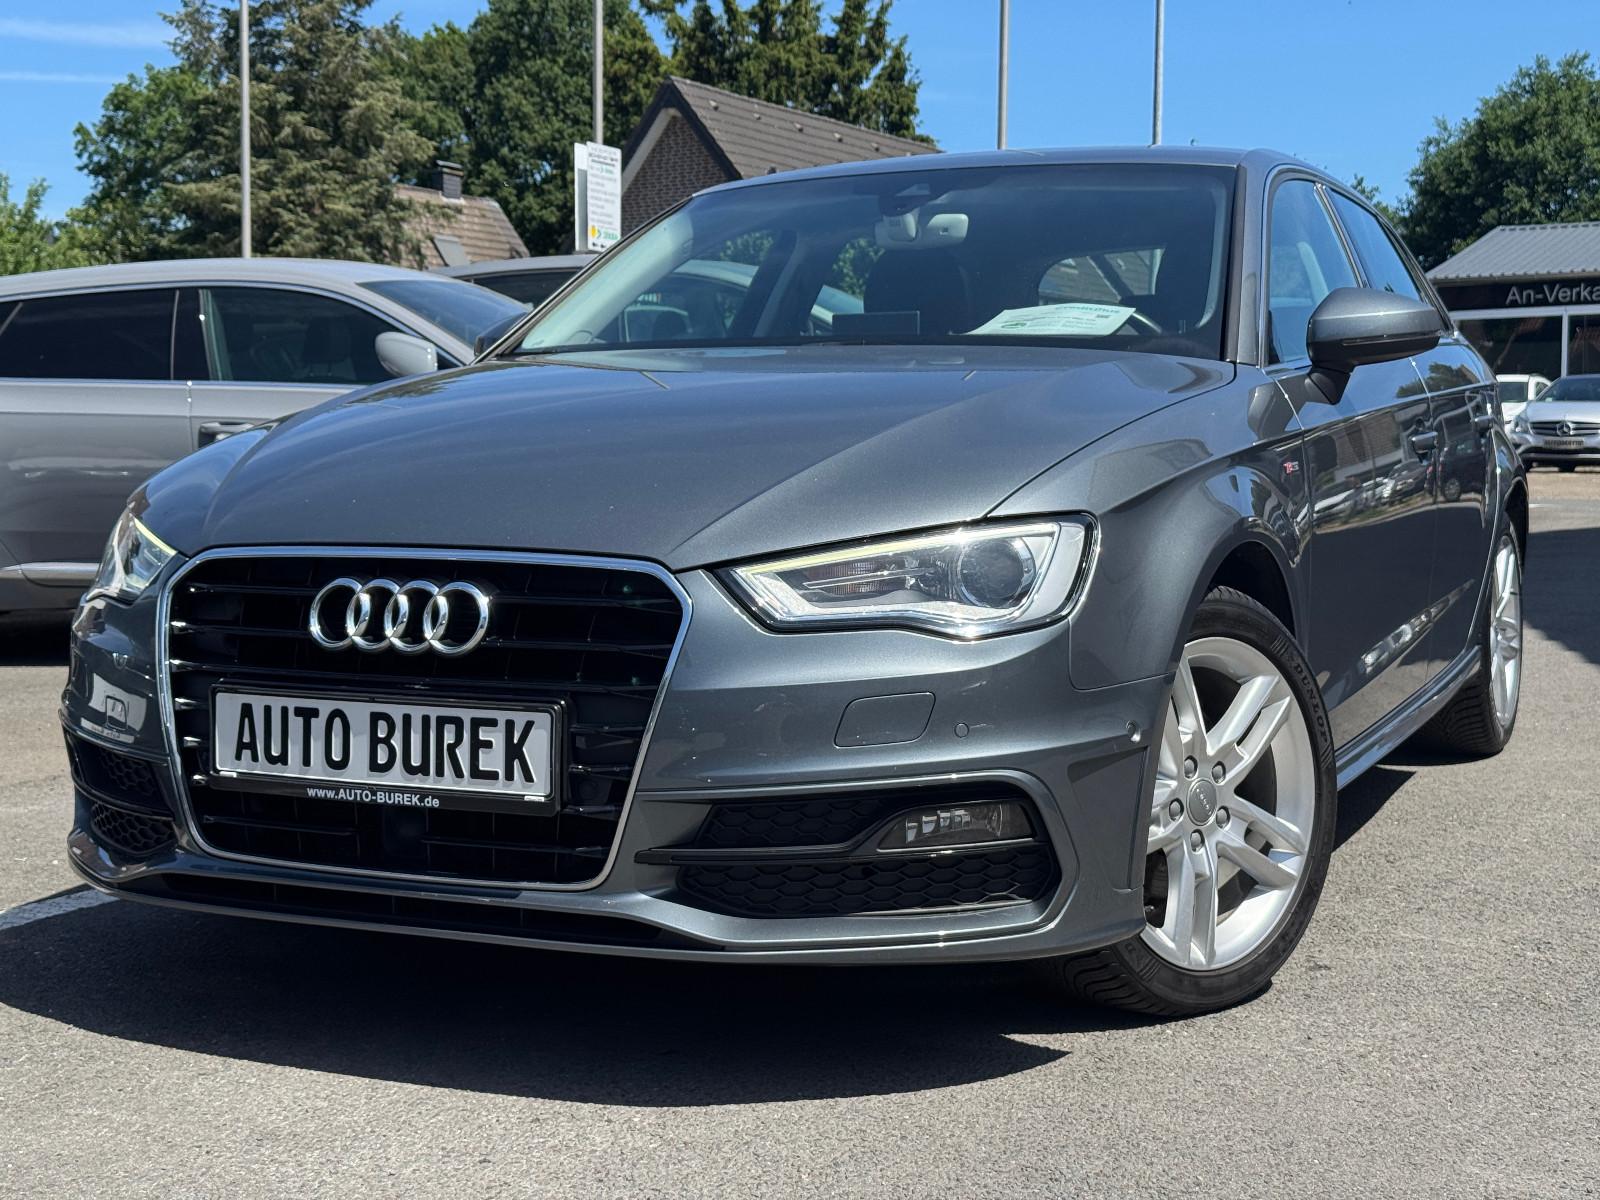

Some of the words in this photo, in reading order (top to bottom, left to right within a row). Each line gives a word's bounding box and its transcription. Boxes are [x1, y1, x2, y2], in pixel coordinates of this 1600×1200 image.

[1505, 282, 1600, 305] An-Verka
[1293, 663, 1329, 743] DUNLOP
[235, 703, 351, 771] AUTO
[369, 711, 536, 783] BUREK
[307, 786, 440, 808] www.AUTO-BUREK.de
